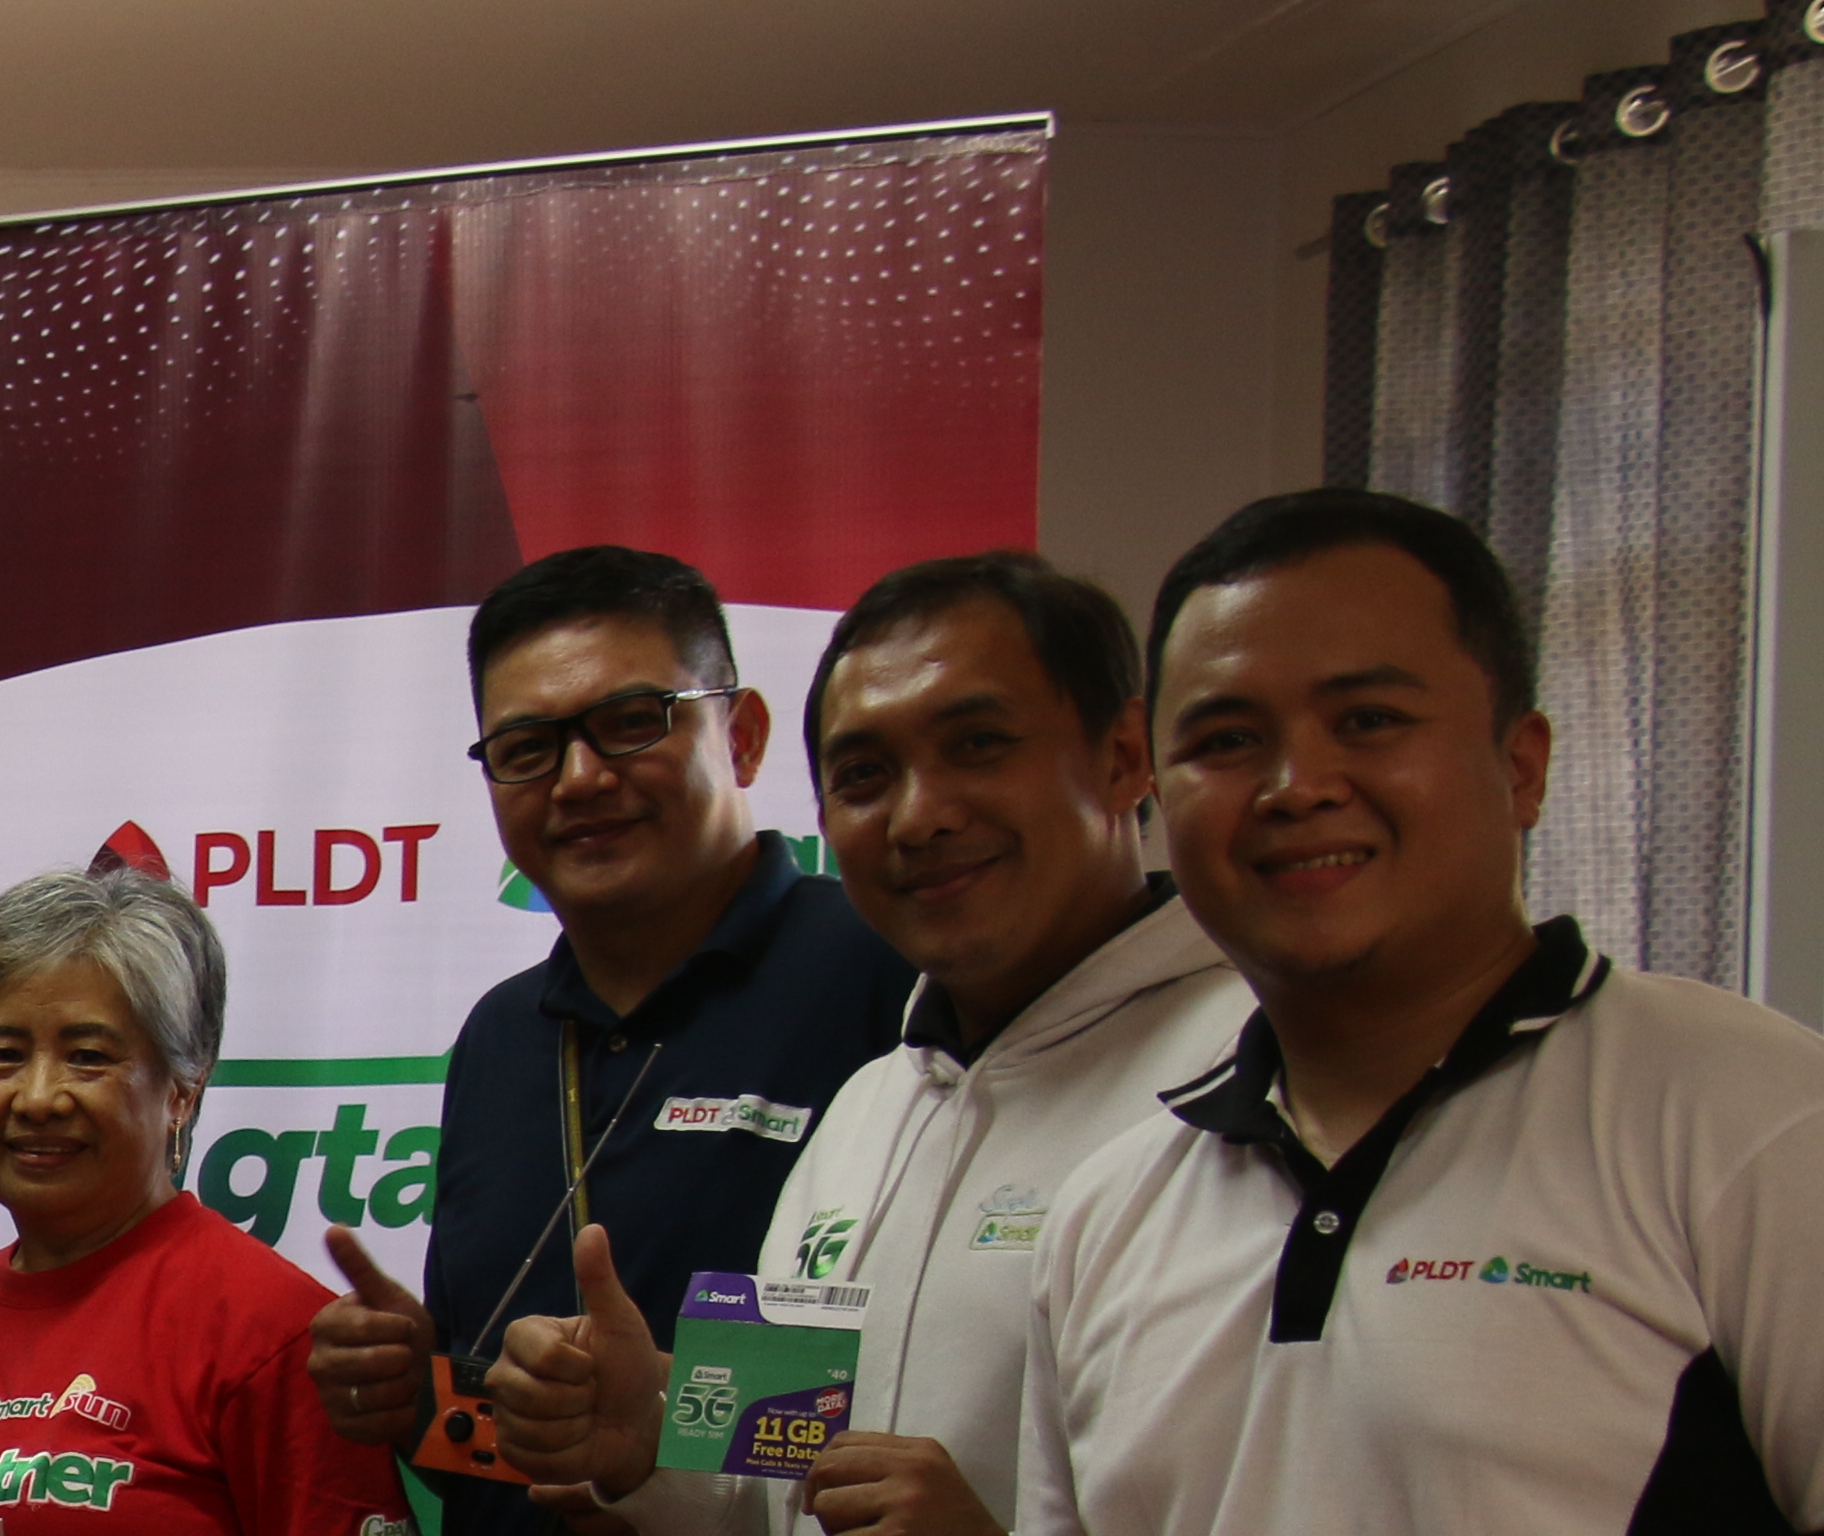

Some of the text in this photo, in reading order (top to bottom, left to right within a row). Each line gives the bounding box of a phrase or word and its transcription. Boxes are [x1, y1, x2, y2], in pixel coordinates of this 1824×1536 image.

[194, 823, 440, 907] PLDT
[668, 1104, 800, 1135] PLDT Smart
[174, 1104, 441, 1250] gta
[1410, 1261, 1592, 1294] PLDT Smart
[708, 1291, 747, 1305] Smart
[54, 1386, 131, 1430] Sun
[671, 1383, 738, 1429] 5G
[754, 1416, 826, 1445] 11 GB
[752, 1442, 822, 1461] Free Data
